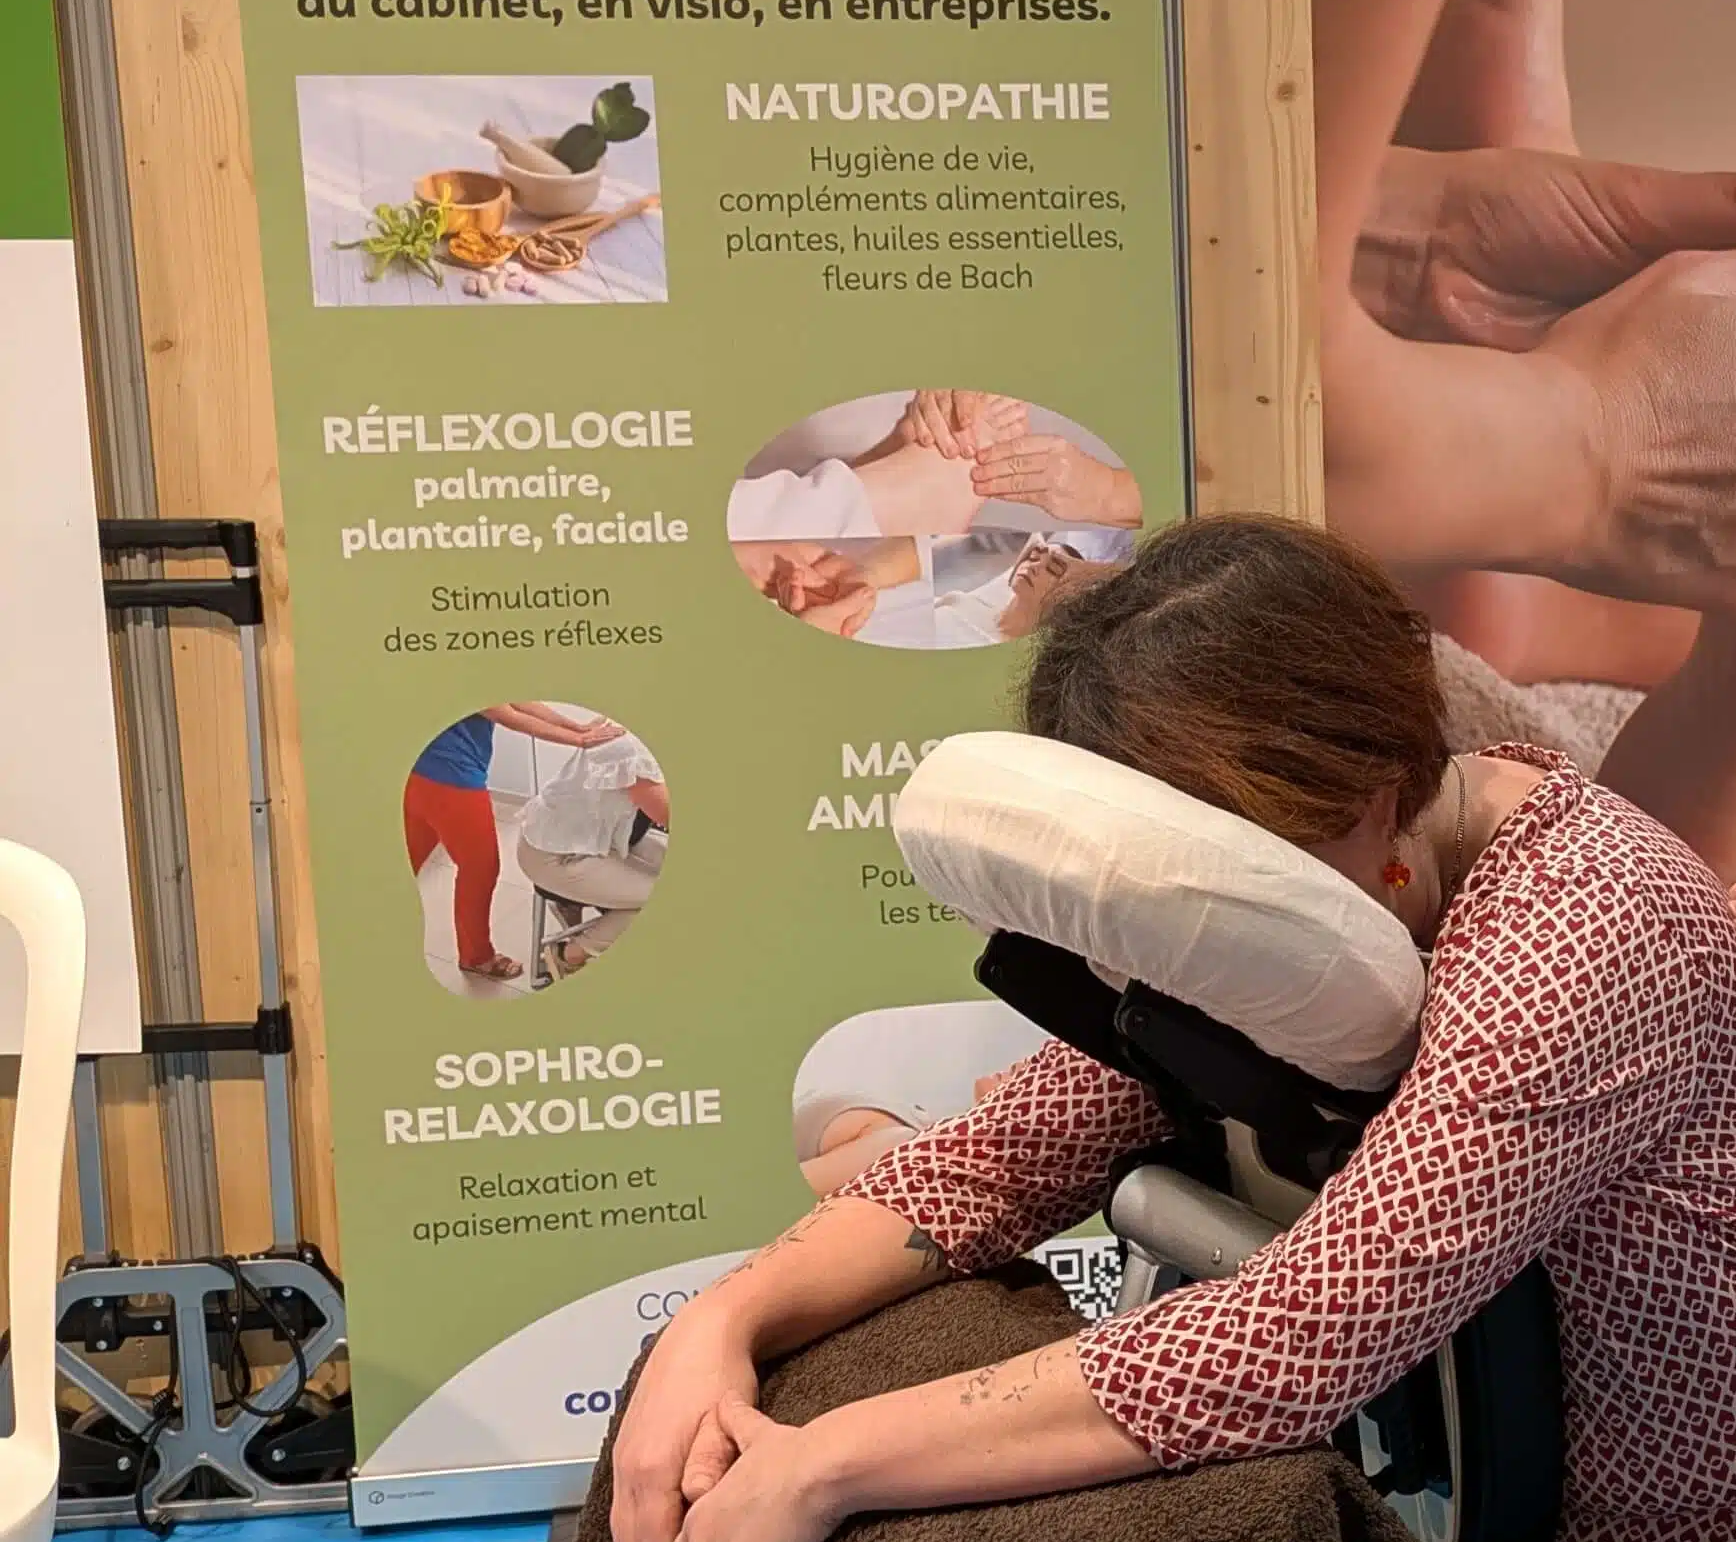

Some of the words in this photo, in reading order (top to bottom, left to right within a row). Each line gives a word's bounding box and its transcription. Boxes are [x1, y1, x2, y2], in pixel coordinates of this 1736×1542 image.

[726, 83, 1109, 120] NATUROPATHIE
[811, 145, 933, 178] Hygiène
[944, 145, 979, 171] de
[988, 146, 1033, 173] vie,
[720, 185, 927, 218] compléments
[936, 185, 1125, 211] alimentaires,
[727, 226, 844, 259] plantes,
[854, 225, 939, 251] huiles
[949, 223, 1123, 251] essentielles,
[823, 265, 907, 291] fleurs
[917, 264, 951, 289] de
[962, 263, 1032, 288] Bach
[324, 404, 693, 453] RÉFLEXOLOGIE
[415, 466, 610, 508] palmaire,
[342, 515, 542, 559] plantaire,
[552, 511, 688, 545] faciale
[432, 583, 609, 611] Stimulation
[384, 627, 437, 652] des
[446, 630, 534, 650] zones
[545, 620, 662, 647] réflexes
[879, 900, 920, 925] les
[928, 901, 962, 923] te
[435, 1043, 663, 1089] SOPHRO-
[385, 1089, 721, 1144] RELAXOLOGIE
[461, 1169, 617, 1200] Relaxation
[628, 1167, 657, 1187] et
[414, 1209, 593, 1245] apaisement
[601, 1195, 707, 1227] mental
[637, 1290, 698, 1321] CO
